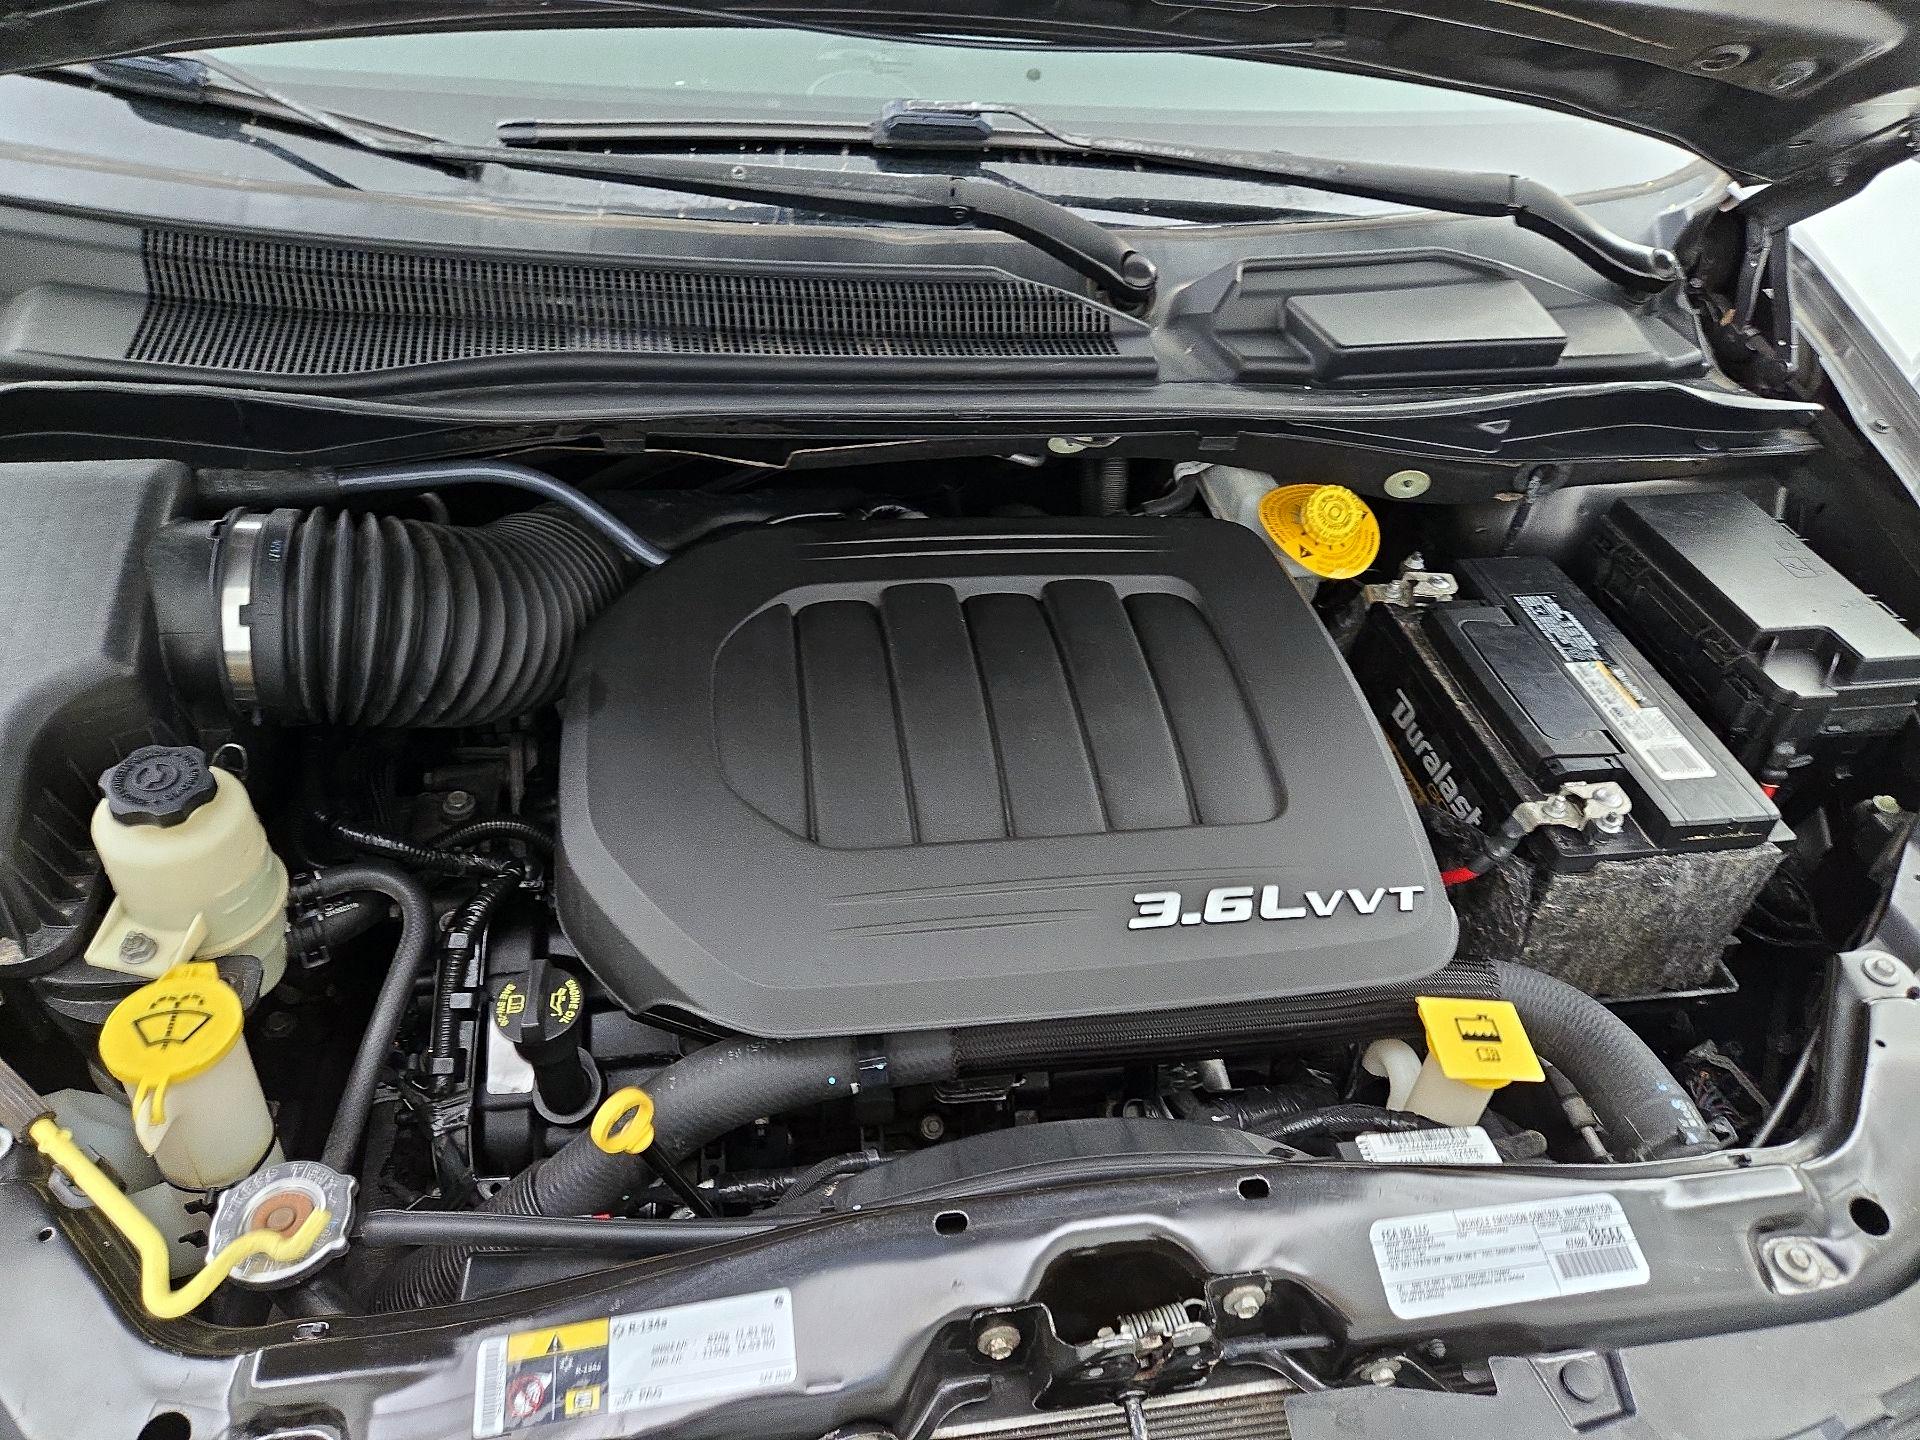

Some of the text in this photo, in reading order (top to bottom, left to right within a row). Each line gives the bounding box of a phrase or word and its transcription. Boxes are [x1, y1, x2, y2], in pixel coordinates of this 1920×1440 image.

[1391, 688, 1483, 826] Duralast
[1127, 884, 1426, 930] 3.6L VVT
[558, 979, 581, 1024] ENGINE OIL
